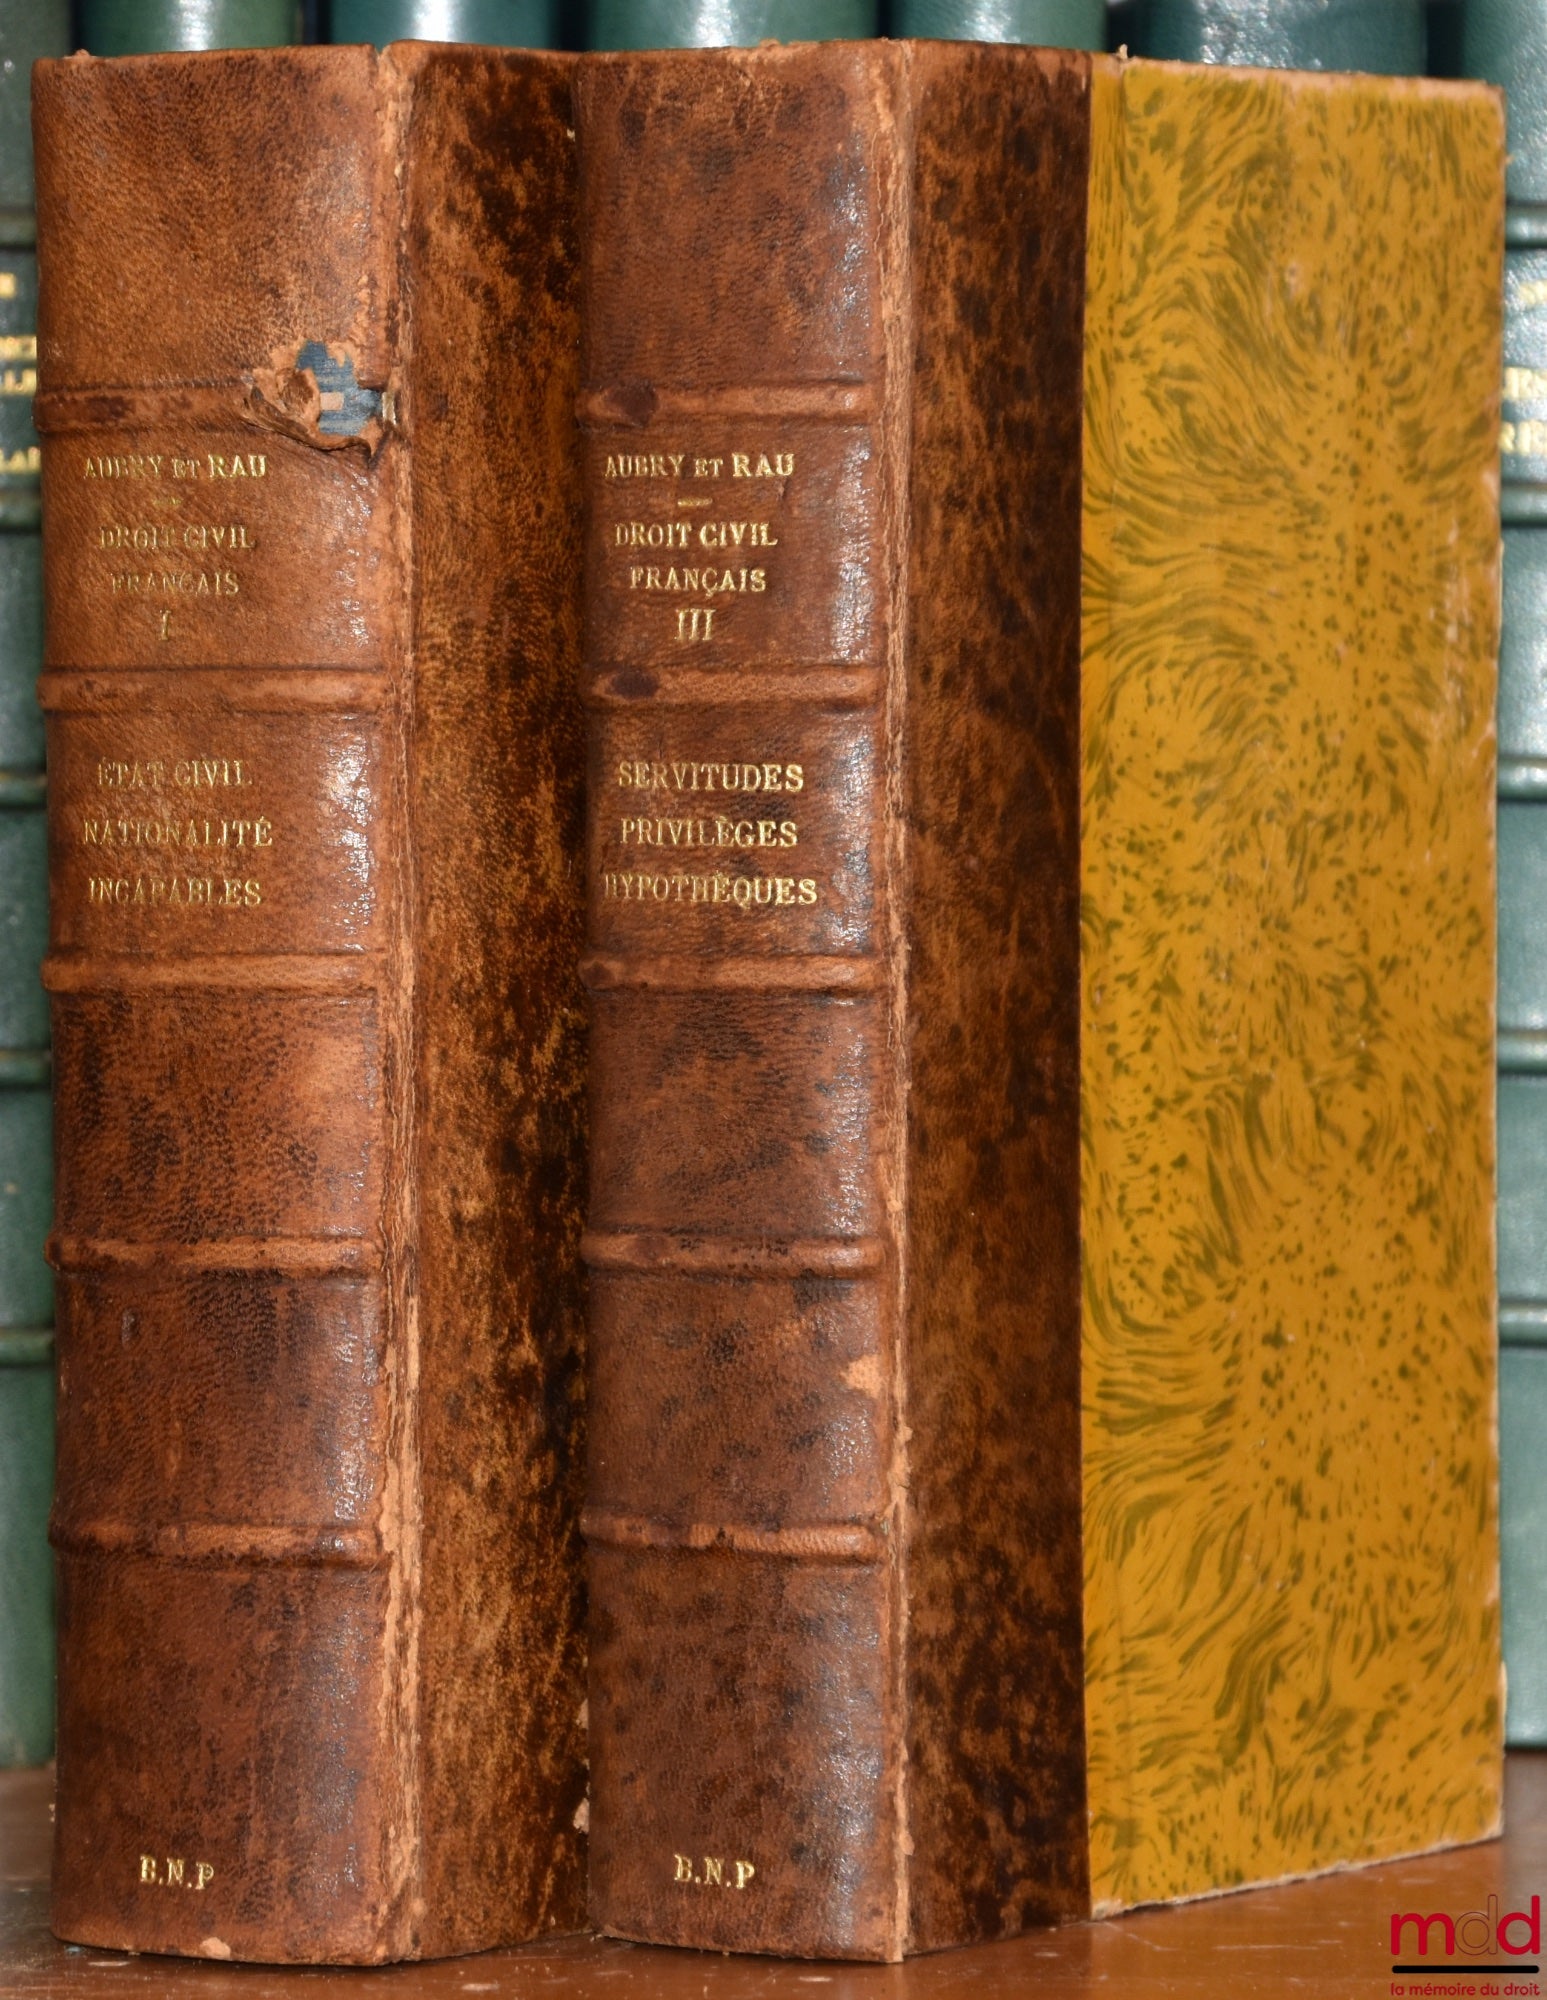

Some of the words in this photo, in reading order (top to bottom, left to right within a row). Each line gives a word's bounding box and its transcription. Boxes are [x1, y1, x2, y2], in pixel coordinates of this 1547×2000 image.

[83, 454, 164, 479] AUBRY
[171, 458, 200, 479] ET
[208, 454, 267, 478] RAU
[604, 454, 685, 479] AUBRY
[693, 458, 724, 478] ET
[732, 452, 795, 478] RAU
[99, 525, 176, 550] DROIT
[183, 523, 257, 549] CIVIL
[615, 521, 692, 547] DROIT
[700, 521, 778, 547] CIVIL
[630, 566, 767, 596] FRANÇAIS
[674, 608, 716, 641] III
[174, 759, 253, 788] CIVIL
[618, 760, 804, 792] SERVITUDES
[620, 815, 798, 847] PRIVILÈGES
[88, 877, 261, 906] INCAPABLES
[140, 1854, 214, 1890] B.N.P
[674, 1853, 755, 1889] B.N.P
